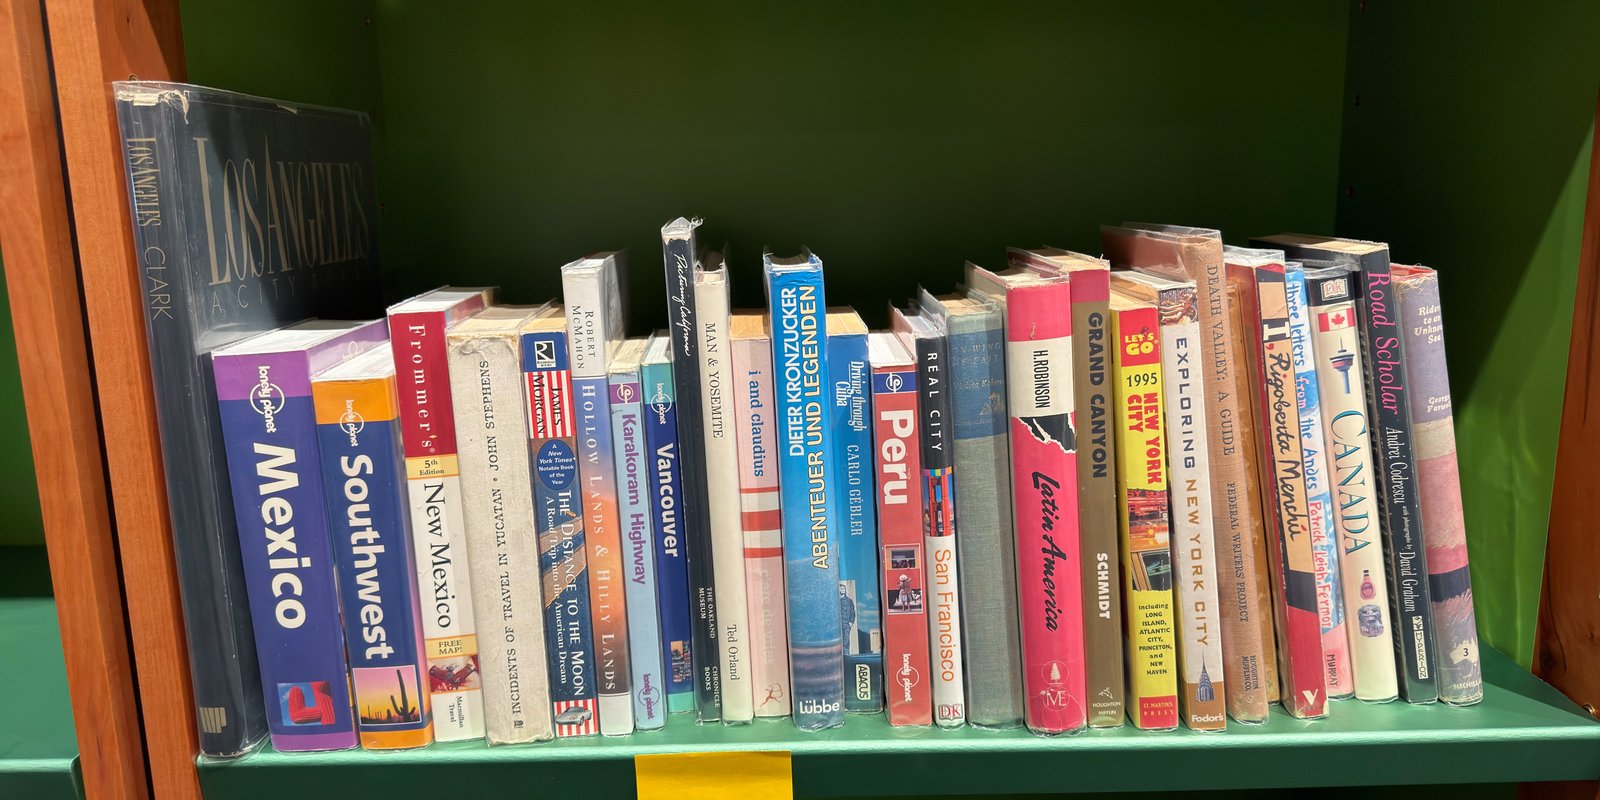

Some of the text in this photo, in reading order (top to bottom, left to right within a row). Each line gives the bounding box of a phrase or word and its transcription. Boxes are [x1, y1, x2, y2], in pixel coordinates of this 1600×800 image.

[144, 246, 174, 321] CLARK
[672, 253, 692, 357] Picturing California
[1324, 281, 1347, 297] DK
[585, 311, 596, 357] ROBERT
[1124, 332, 1155, 344] LET'S
[1125, 342, 1154, 356] GO
[1206, 264, 1234, 457] DEATH VALLEY: A GUIDE
[1367, 271, 1403, 416] Road Scholar
[257, 365, 278, 433] lonely planet
[532, 374, 547, 434] MORGAN
[656, 383, 667, 425] lonely planet
[705, 322, 724, 438] MAN & YOSEMITE
[748, 381, 763, 409] and
[781, 287, 805, 457] DIETER KRONZUCKER
[835, 381, 850, 407] Cuba
[848, 360, 867, 432] Driving through
[927, 352, 943, 451] REAL CITY
[1088, 312, 1107, 479] GRAND CANYON
[1126, 372, 1158, 388] 1995
[1266, 352, 1296, 456] Rigoberta
[1286, 283, 1319, 490] three letters from the Andes
[345, 400, 359, 447] lonely planet
[551, 386, 563, 426] JAMES
[799, 284, 830, 570] ABENTEUER UND LEGENDEN
[1127, 394, 1144, 433] CITY
[1143, 392, 1160, 431] NEW
[419, 468, 445, 476] Edition
[424, 459, 438, 469] 5th
[750, 413, 766, 477] claudius
[881, 409, 915, 505] Peru
[1145, 436, 1162, 485] YORK
[1385, 426, 1409, 505] Andrei Codrescu
[622, 414, 646, 585] Karakoram Highway
[656, 443, 679, 558] Vancouver
[847, 444, 864, 537] CARLO GÉBLER
[1176, 337, 1209, 647] EXPLORING NEW YORK CITY
[1279, 459, 1308, 542] Menchú
[1331, 410, 1372, 556] CANADA
[254, 443, 312, 629] Mexico
[340, 454, 395, 660] Southwest
[424, 482, 456, 629] New Mexico
[479, 360, 522, 714] INCIDENTS OF TRAVEL IN YUCATAN JOHN STEPHENS
[582, 385, 616, 691] HOLLOW LANDS & HILLY LANDS
[1031, 470, 1067, 633] Latin America
[1225, 481, 1249, 623] FEDERAL WRITERS' PROJECT
[1309, 501, 1332, 629] Patrick Leigh Fermor
[546, 496, 568, 685] A Road Trip into the American Dream
[558, 489, 585, 697] THE DISTANCE TO THE MOON
[698, 587, 707, 620] MUSEUM
[1096, 552, 1110, 620] SCHMIDT
[1138, 603, 1169, 611] Including
[1399, 551, 1419, 613] David Graham
[438, 639, 462, 648] FREE
[708, 603, 716, 639] OAKLAND
[935, 549, 957, 682] San Francisco
[1138, 643, 1173, 651] PRINCETON,
[1139, 627, 1171, 635] ATLANTIC
[438, 646, 463, 655] MAP!
[704, 666, 712, 691] BOOKS
[726, 624, 740, 681] Ted Orland
[857, 665, 869, 699] ABACUS
[902, 653, 913, 702] lonely planet
[1326, 654, 1339, 687] MURRAY
[712, 665, 721, 708] CHRONICLE
[799, 699, 841, 715] Lübbe
[940, 704, 963, 719] DK
[1191, 711, 1224, 723] Fodor's
